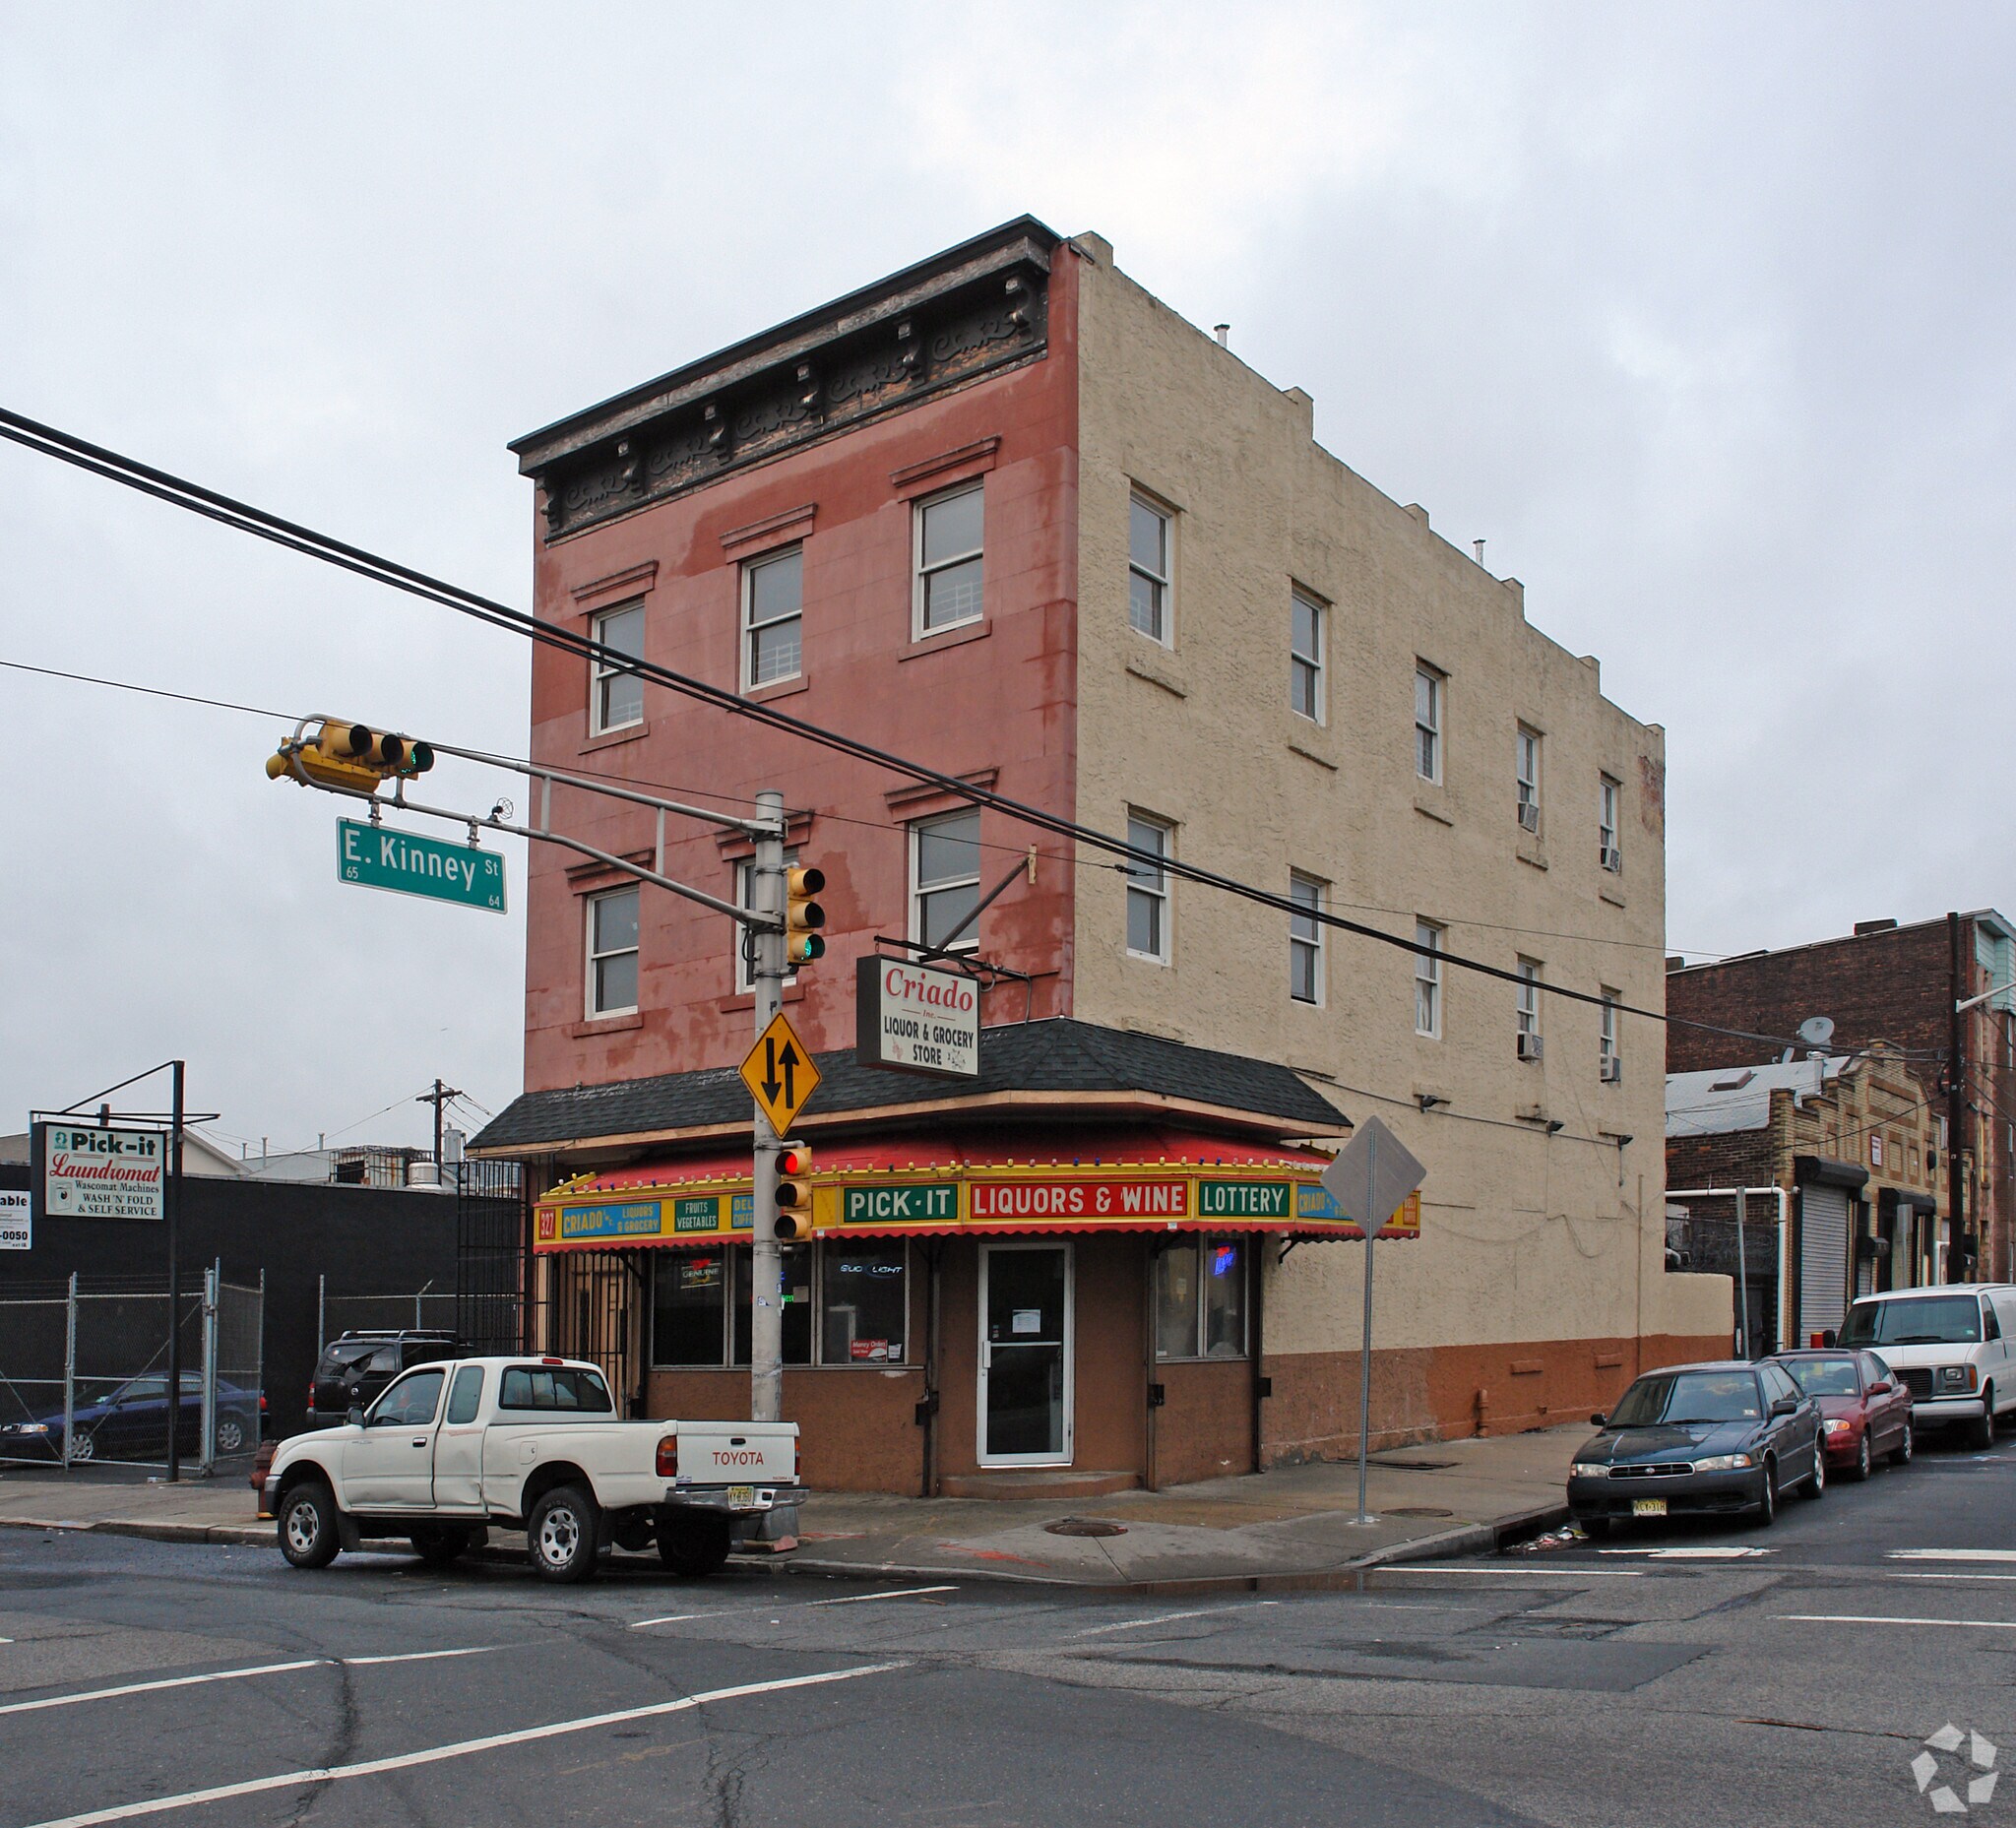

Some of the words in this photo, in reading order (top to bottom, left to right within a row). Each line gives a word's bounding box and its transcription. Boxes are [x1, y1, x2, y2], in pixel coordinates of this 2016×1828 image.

[345, 828, 371, 864] E.
[380, 835, 475, 892] Kinney
[484, 858, 499, 876] St
[346, 865, 359, 880] 65
[487, 894, 500, 908] 64
[885, 968, 974, 1012] Criado
[884, 1015, 919, 1040] LIQUOR
[922, 1023, 929, 1041] &
[932, 1026, 975, 1048] GROCERY
[913, 1043, 942, 1065] STORE
[71, 1132, 156, 1156] Pick-it
[49, 1153, 160, 1183] Laundromat
[75, 1179, 117, 1191] Wascomat
[119, 1182, 159, 1193] Machines
[83, 1193, 110, 1204] WASH
[127, 1196, 154, 1205] FOLD
[974, 1187, 1084, 1214] LIQUORS
[1096, 1186, 1111, 1213] &
[1121, 1185, 1183, 1212] WINE
[1204, 1186, 1284, 1213] LOTTERY
[78, 1204, 86, 1213] &
[89, 1204, 113, 1214] SELF
[115, 1205, 157, 1216] SERVICE
[622, 1206, 654, 1219] LIQUORS
[685, 1202, 709, 1215] FRUITS
[540, 1212, 554, 1236] 327
[625, 1219, 659, 1231] GROCERY
[676, 1215, 717, 1229] VEGETABLES
[712, 1451, 764, 1466] TOYOTA
